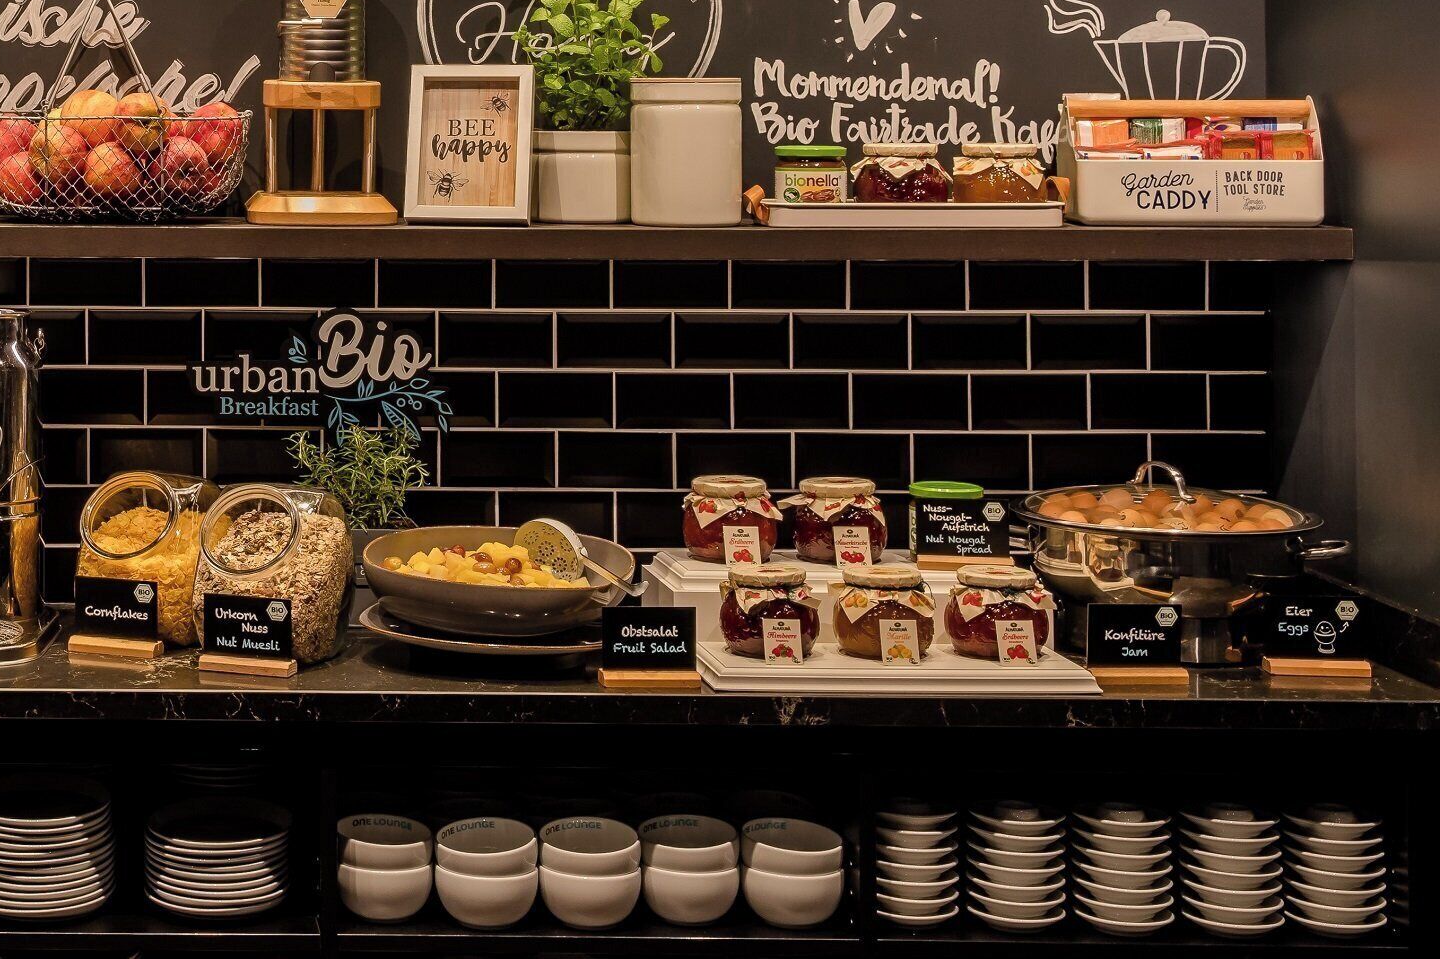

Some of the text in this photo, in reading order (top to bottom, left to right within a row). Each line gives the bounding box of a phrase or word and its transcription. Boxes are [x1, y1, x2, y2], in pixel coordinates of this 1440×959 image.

[447, 119, 496, 137] BEE
[751, 102, 819, 145] Bio
[830, 102, 981, 145] Fairtrade
[431, 133, 512, 163] happy
[785, 173, 839, 186] bionella
[1224, 170, 1283, 183] BACK DOOR
[1121, 170, 1194, 197] Garden
[1223, 183, 1286, 196] TOOL STORE
[1136, 190, 1211, 210] CADDY
[192, 313, 432, 393] urban Bio
[219, 396, 319, 416] Breakfast
[922, 504, 953, 513] Nuss-
[928, 512, 972, 524] Nougat-
[941, 522, 990, 533] Aufstrich
[925, 534, 986, 547] Nut Nougat
[956, 544, 993, 557] Spread
[85, 605, 148, 621] Cornflakes
[215, 607, 258, 622] Urkorn
[1285, 606, 1313, 618] Eier
[241, 622, 269, 634] Nuss
[621, 624, 678, 638] Obstsalat
[1278, 622, 1309, 636] Eggs
[1104, 627, 1166, 643] Konfitüre
[216, 636, 280, 651] Nut Muesli
[613, 642, 687, 653] Fruit Salad
[1121, 646, 1148, 657] Jam
[456, 821, 496, 832] LOUNGE
